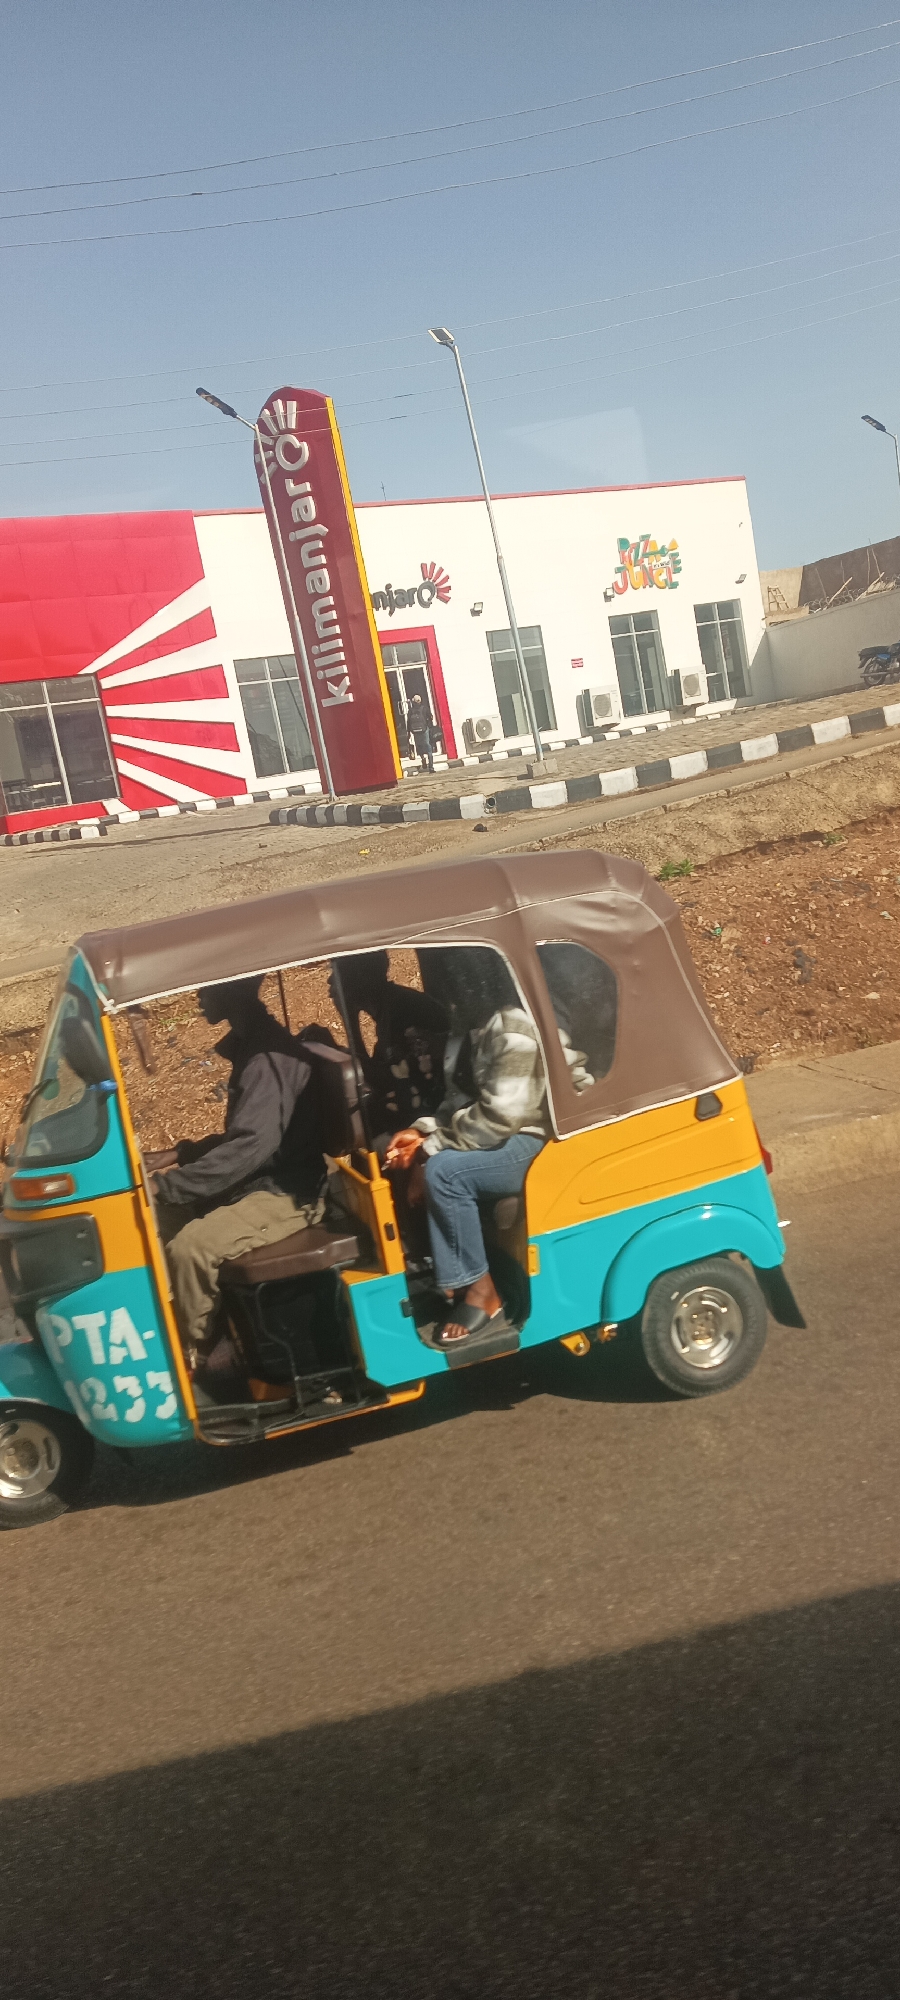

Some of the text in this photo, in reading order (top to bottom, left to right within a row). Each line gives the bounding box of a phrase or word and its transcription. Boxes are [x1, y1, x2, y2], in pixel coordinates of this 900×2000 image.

[617, 534, 662, 567] PIZZA
[612, 552, 682, 595] JUNGLE
[370, 581, 436, 617] njaro
[36, 1306, 155, 1365] PTA-
[64, 1371, 178, 1425] 1233
